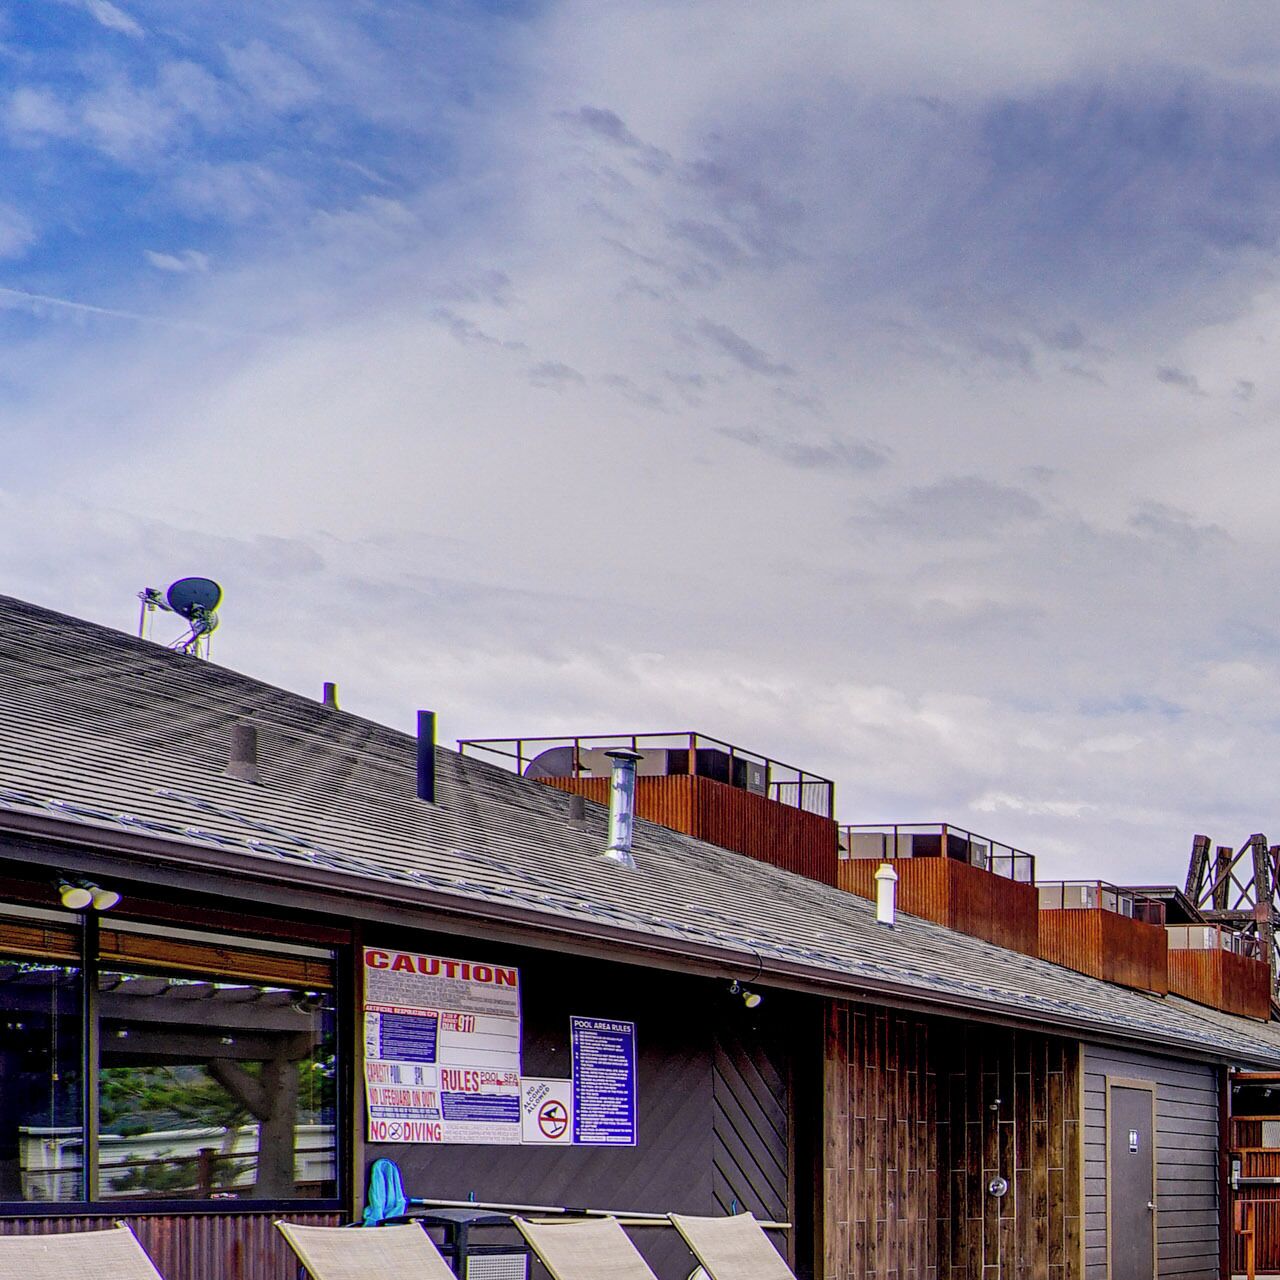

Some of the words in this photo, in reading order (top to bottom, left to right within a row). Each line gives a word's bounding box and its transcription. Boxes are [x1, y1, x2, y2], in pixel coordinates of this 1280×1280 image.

[365, 950, 517, 986] CAUTION
[458, 1015, 474, 1033] 911
[574, 1020, 592, 1029] POOL
[594, 1022, 611, 1030] AREA
[611, 1024, 631, 1033] RULES
[441, 1069, 480, 1092] RULES
[480, 1071, 499, 1082] POOL
[504, 1072, 518, 1083] SPA
[369, 1087, 379, 1105] NO
[380, 1088, 411, 1107] LIFEGUARD
[412, 1090, 421, 1107] ON
[422, 1090, 436, 1108] DUTY
[524, 1083, 546, 1109] ALCOHOL
[526, 1086, 535, 1096] NO
[527, 1087, 550, 1114] ALLOWED
[371, 1121, 387, 1140] NO
[403, 1122, 442, 1142] DIVING
